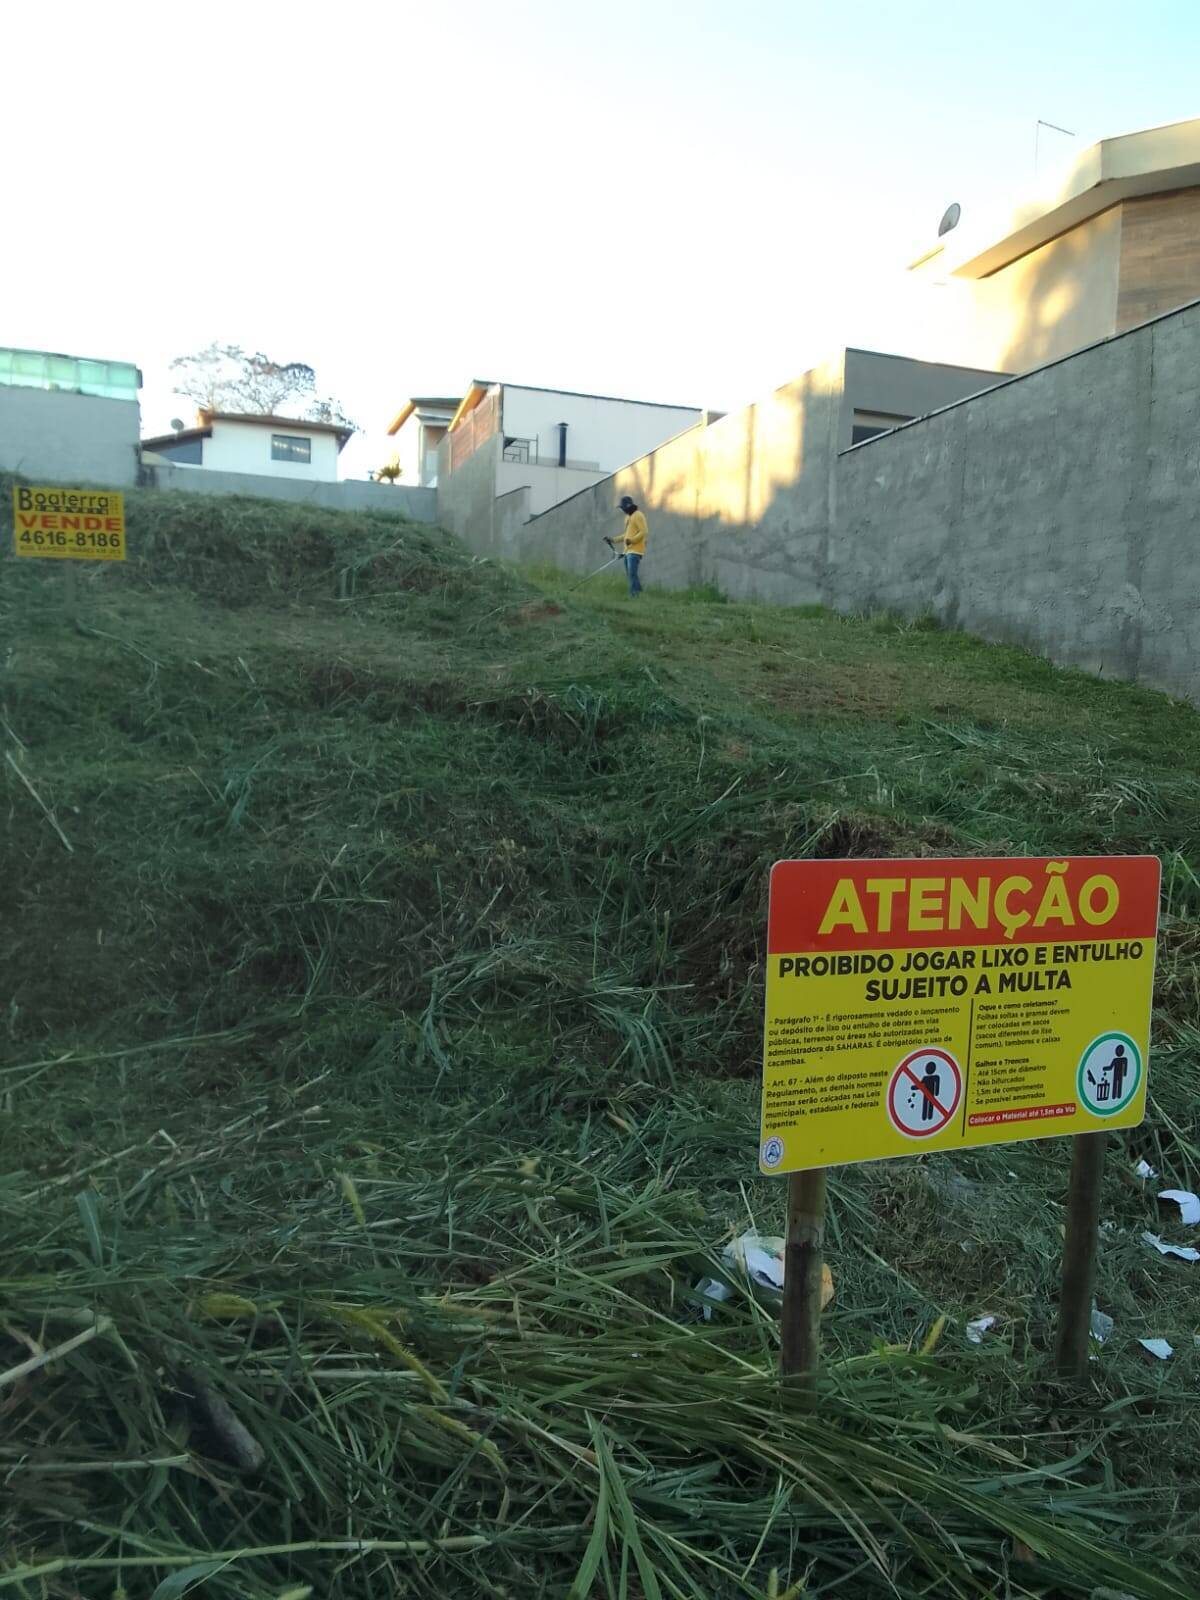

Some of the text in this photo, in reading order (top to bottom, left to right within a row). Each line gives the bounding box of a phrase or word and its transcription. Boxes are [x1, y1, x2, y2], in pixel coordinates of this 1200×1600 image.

[18, 488, 109, 511] Boaterra
[17, 514, 122, 532] VENDE
[20, 530, 120, 547] 4616-8186
[817, 861, 1120, 940] ATENÇÃO
[779, 942, 1143, 978] PROIBIDO JOGAR LIXO E ENTULHO
[865, 969, 1072, 1002] SUJEITO A MULTA
[774, 1016, 811, 1025] Parágrafo
[832, 1012, 884, 1022] rigorosamente
[886, 1009, 912, 1017] vedado
[920, 1007, 960, 1016] lançamento
[780, 1026, 813, 1036] depósito
[853, 1021, 880, 1030] entulho
[882, 1020, 890, 1028] de
[804, 1035, 834, 1043] terrenos
[847, 1032, 866, 1040] áreas
[868, 1030, 882, 1038] não
[883, 1028, 924, 1038] autorizadas
[925, 1026, 940, 1034] pela
[768, 1046, 824, 1056] administradora
[825, 1044, 834, 1052] da
[882, 1038, 922, 1047] obrigatório
[976, 1060, 997, 1068] Galhos
[804, 1076, 824, 1084] Além
[826, 1074, 835, 1082] do
[837, 1072, 868, 1080] disposto
[829, 1083, 855, 1091] demais
[798, 1096, 818, 1105] serão
[809, 1104, 843, 1114] estaduais
[851, 1100, 879, 1109] federais
[970, 1116, 995, 1124] Colocar
[1002, 1110, 1028, 1120] Material
